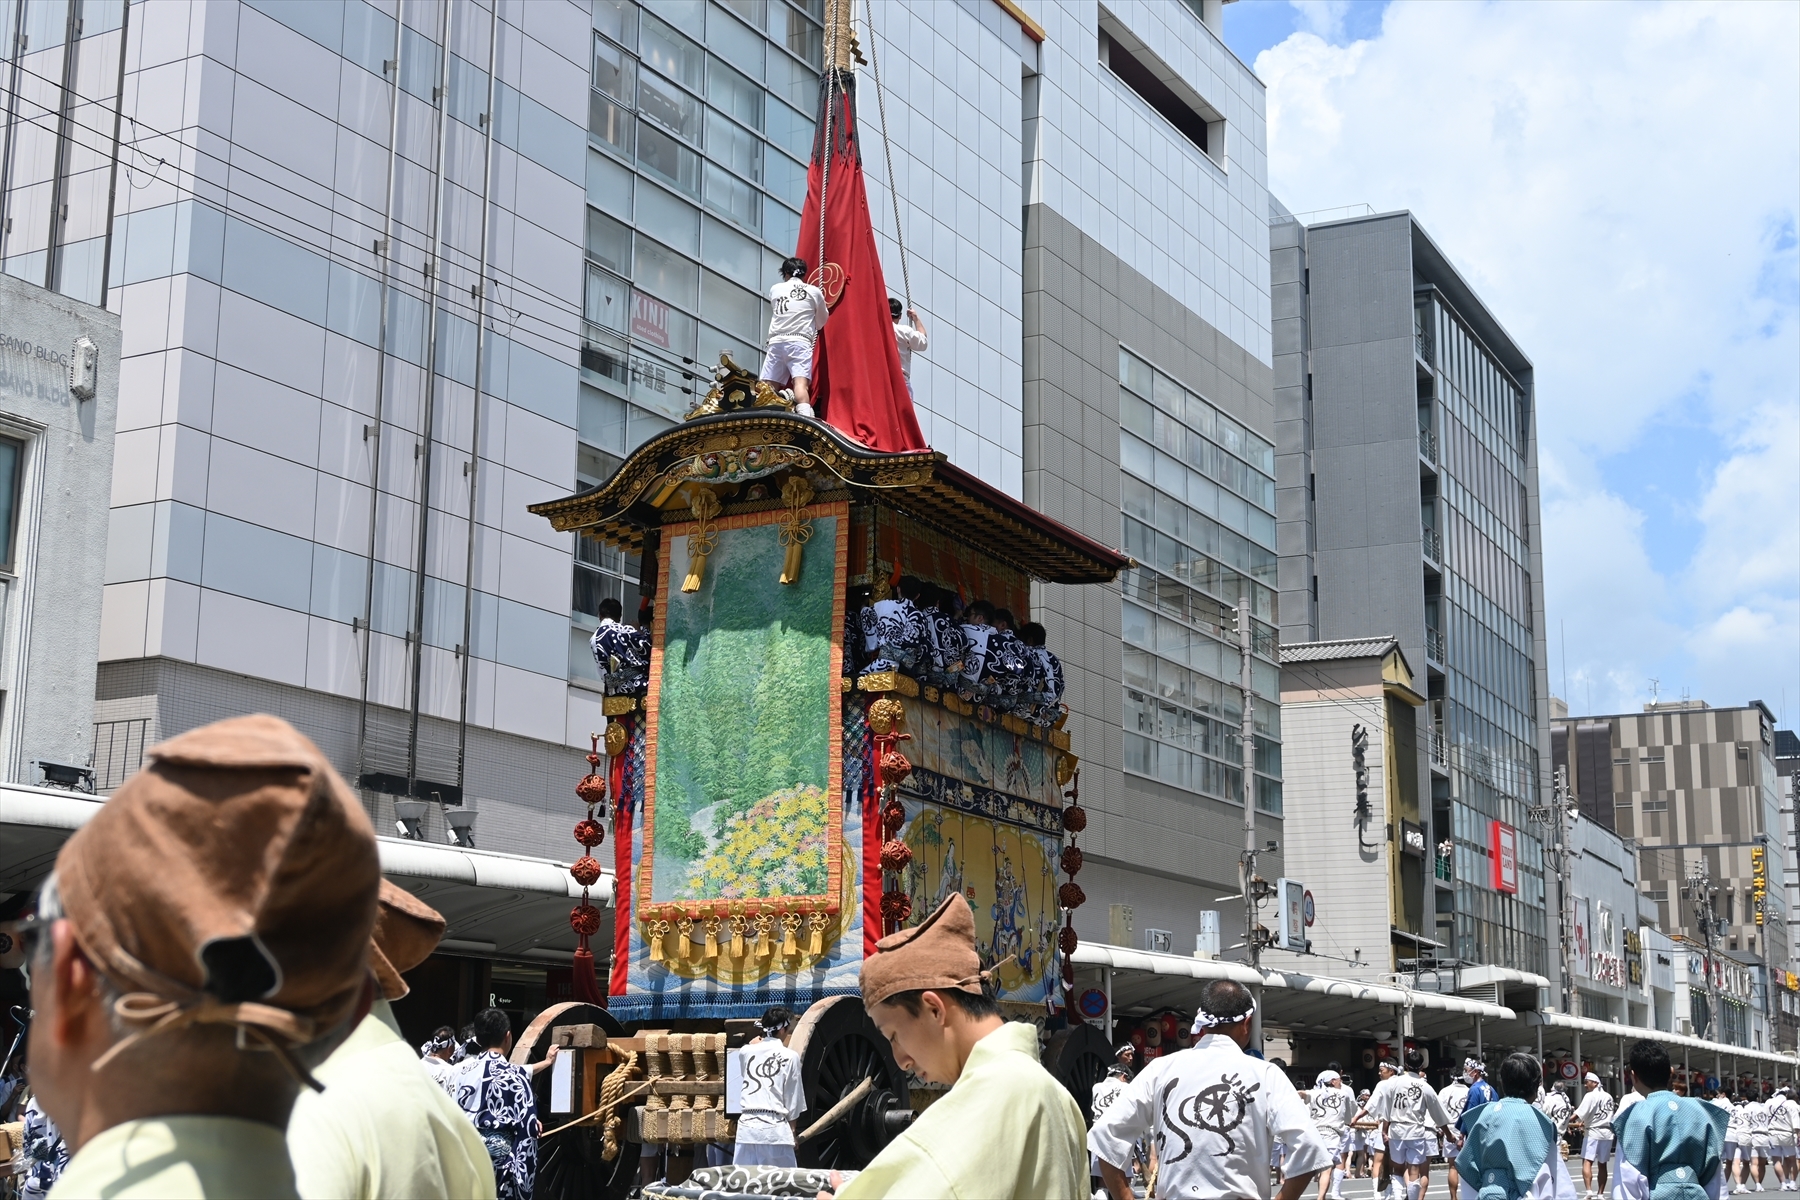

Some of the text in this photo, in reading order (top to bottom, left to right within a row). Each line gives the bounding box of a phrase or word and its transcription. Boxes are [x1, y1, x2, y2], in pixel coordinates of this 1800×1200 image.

[632, 293, 669, 335] KINJI
[636, 323, 665, 343] used clothing
[631, 358, 666, 394] 古着屋
[1305, 900, 1312, 917] 40
